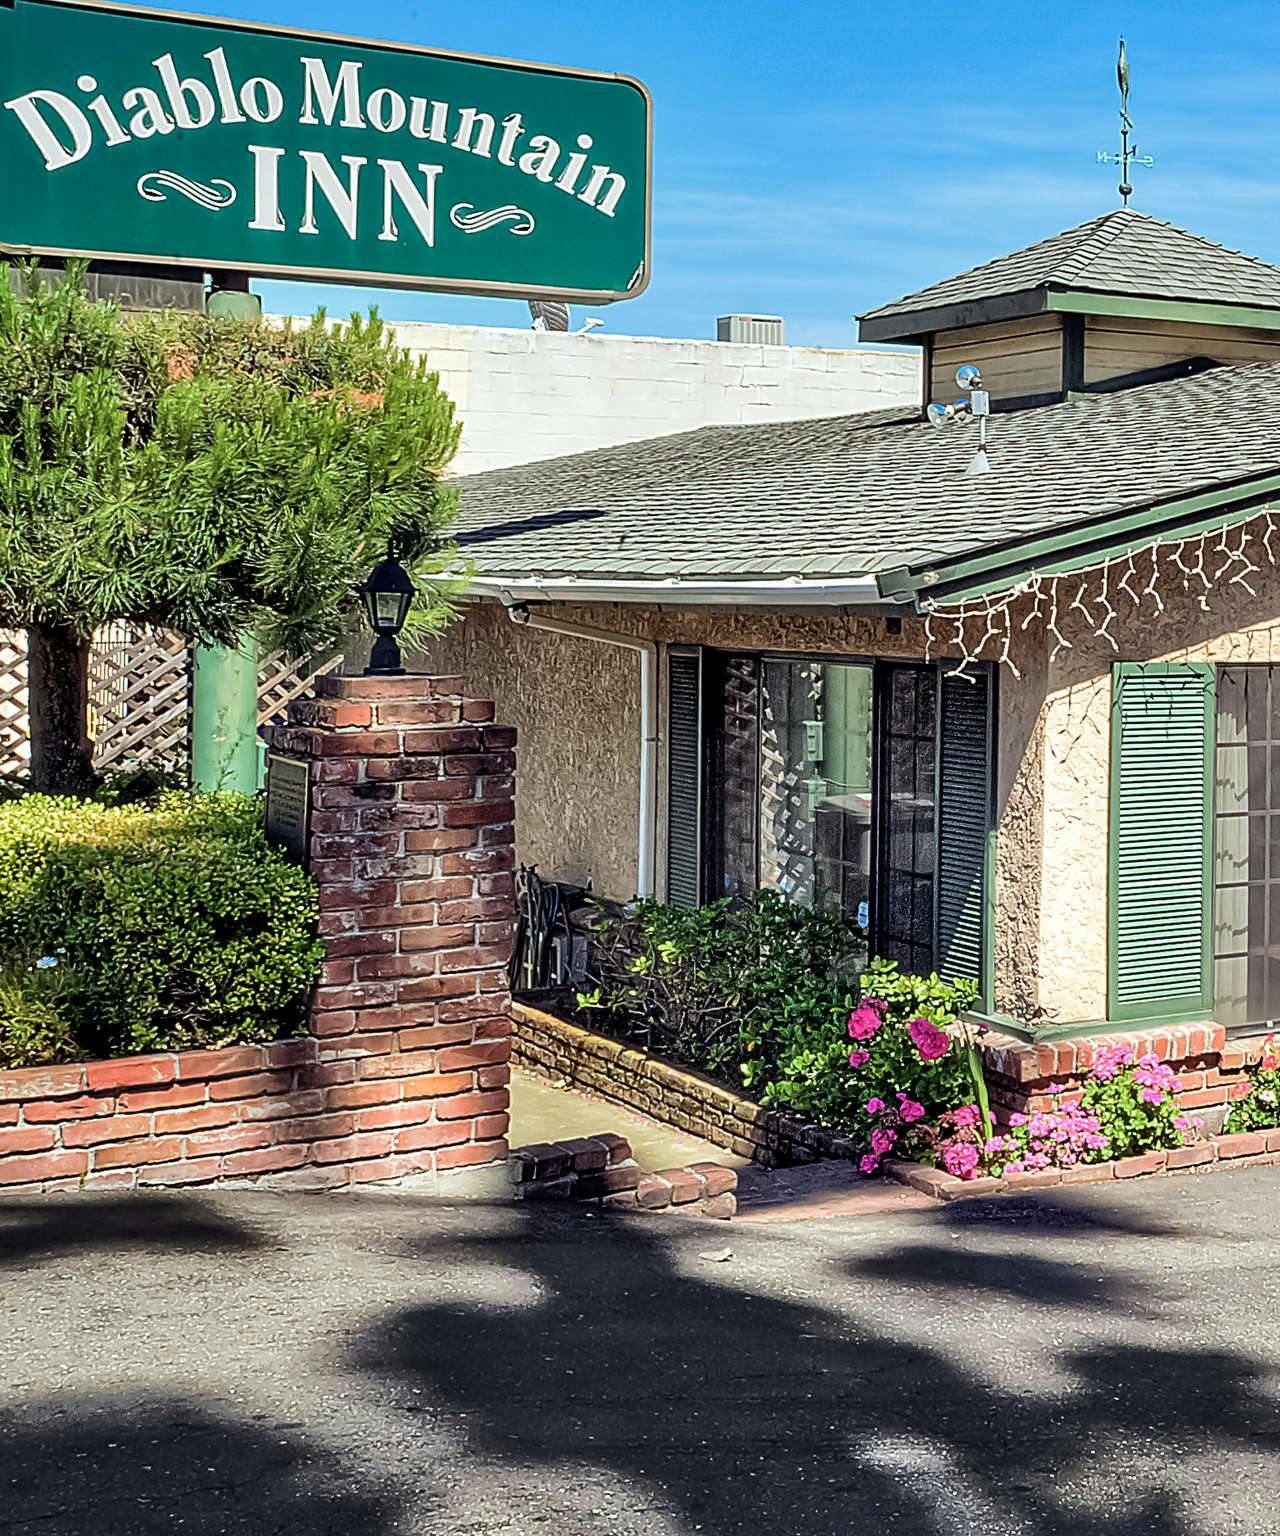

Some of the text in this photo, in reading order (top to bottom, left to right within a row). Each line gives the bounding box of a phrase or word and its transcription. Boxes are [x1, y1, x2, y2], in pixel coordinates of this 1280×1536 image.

[4, 46, 626, 218] Diablo Mountain
[247, 144, 443, 247] INN
